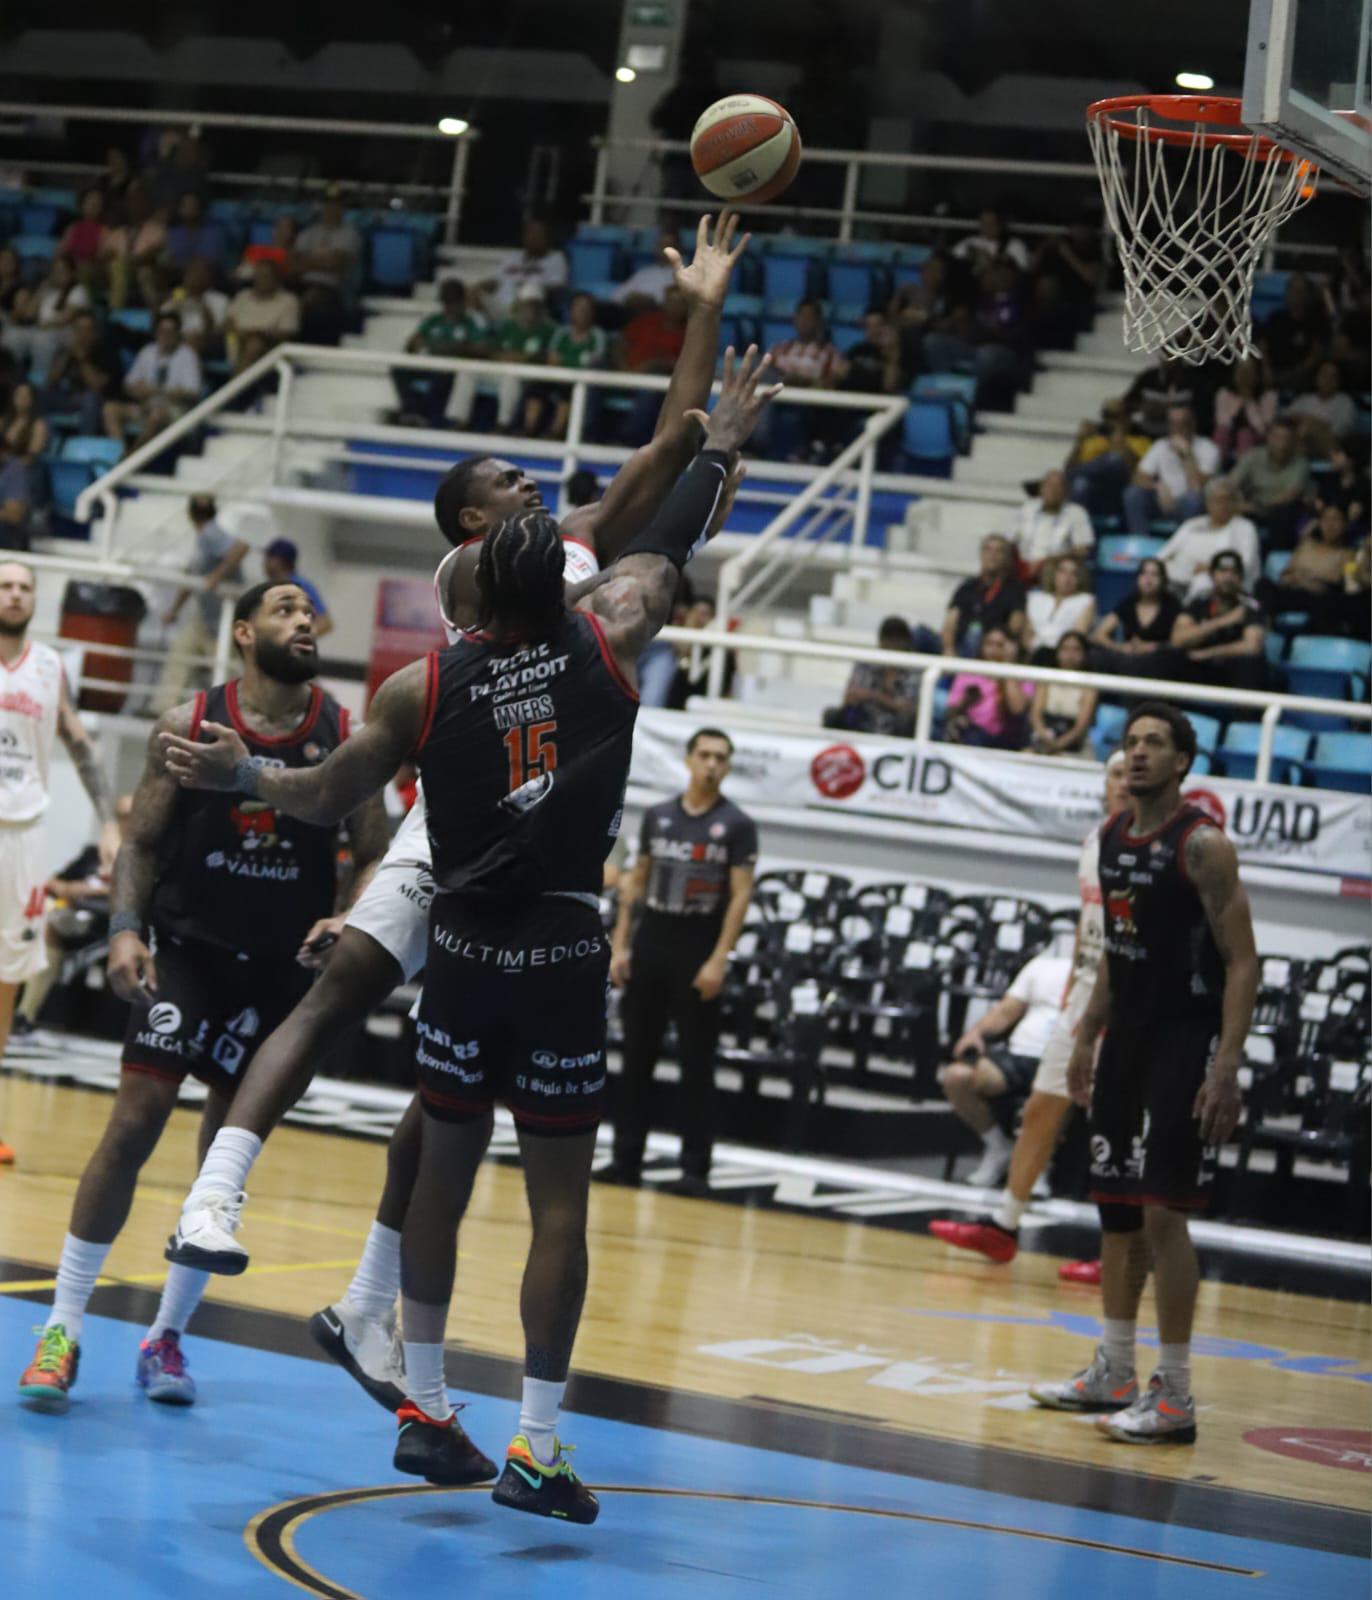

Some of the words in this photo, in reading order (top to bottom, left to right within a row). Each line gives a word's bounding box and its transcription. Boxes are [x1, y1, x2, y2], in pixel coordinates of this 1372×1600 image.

[470, 654, 570, 701] PLAYDOIT
[494, 694, 555, 729] MYERS
[503, 720, 558, 792] 15
[872, 752, 952, 796] CID
[1232, 794, 1320, 846] UAD
[434, 924, 601, 973] MULTIMEDIOS
[135, 1031, 183, 1056] MEGA
